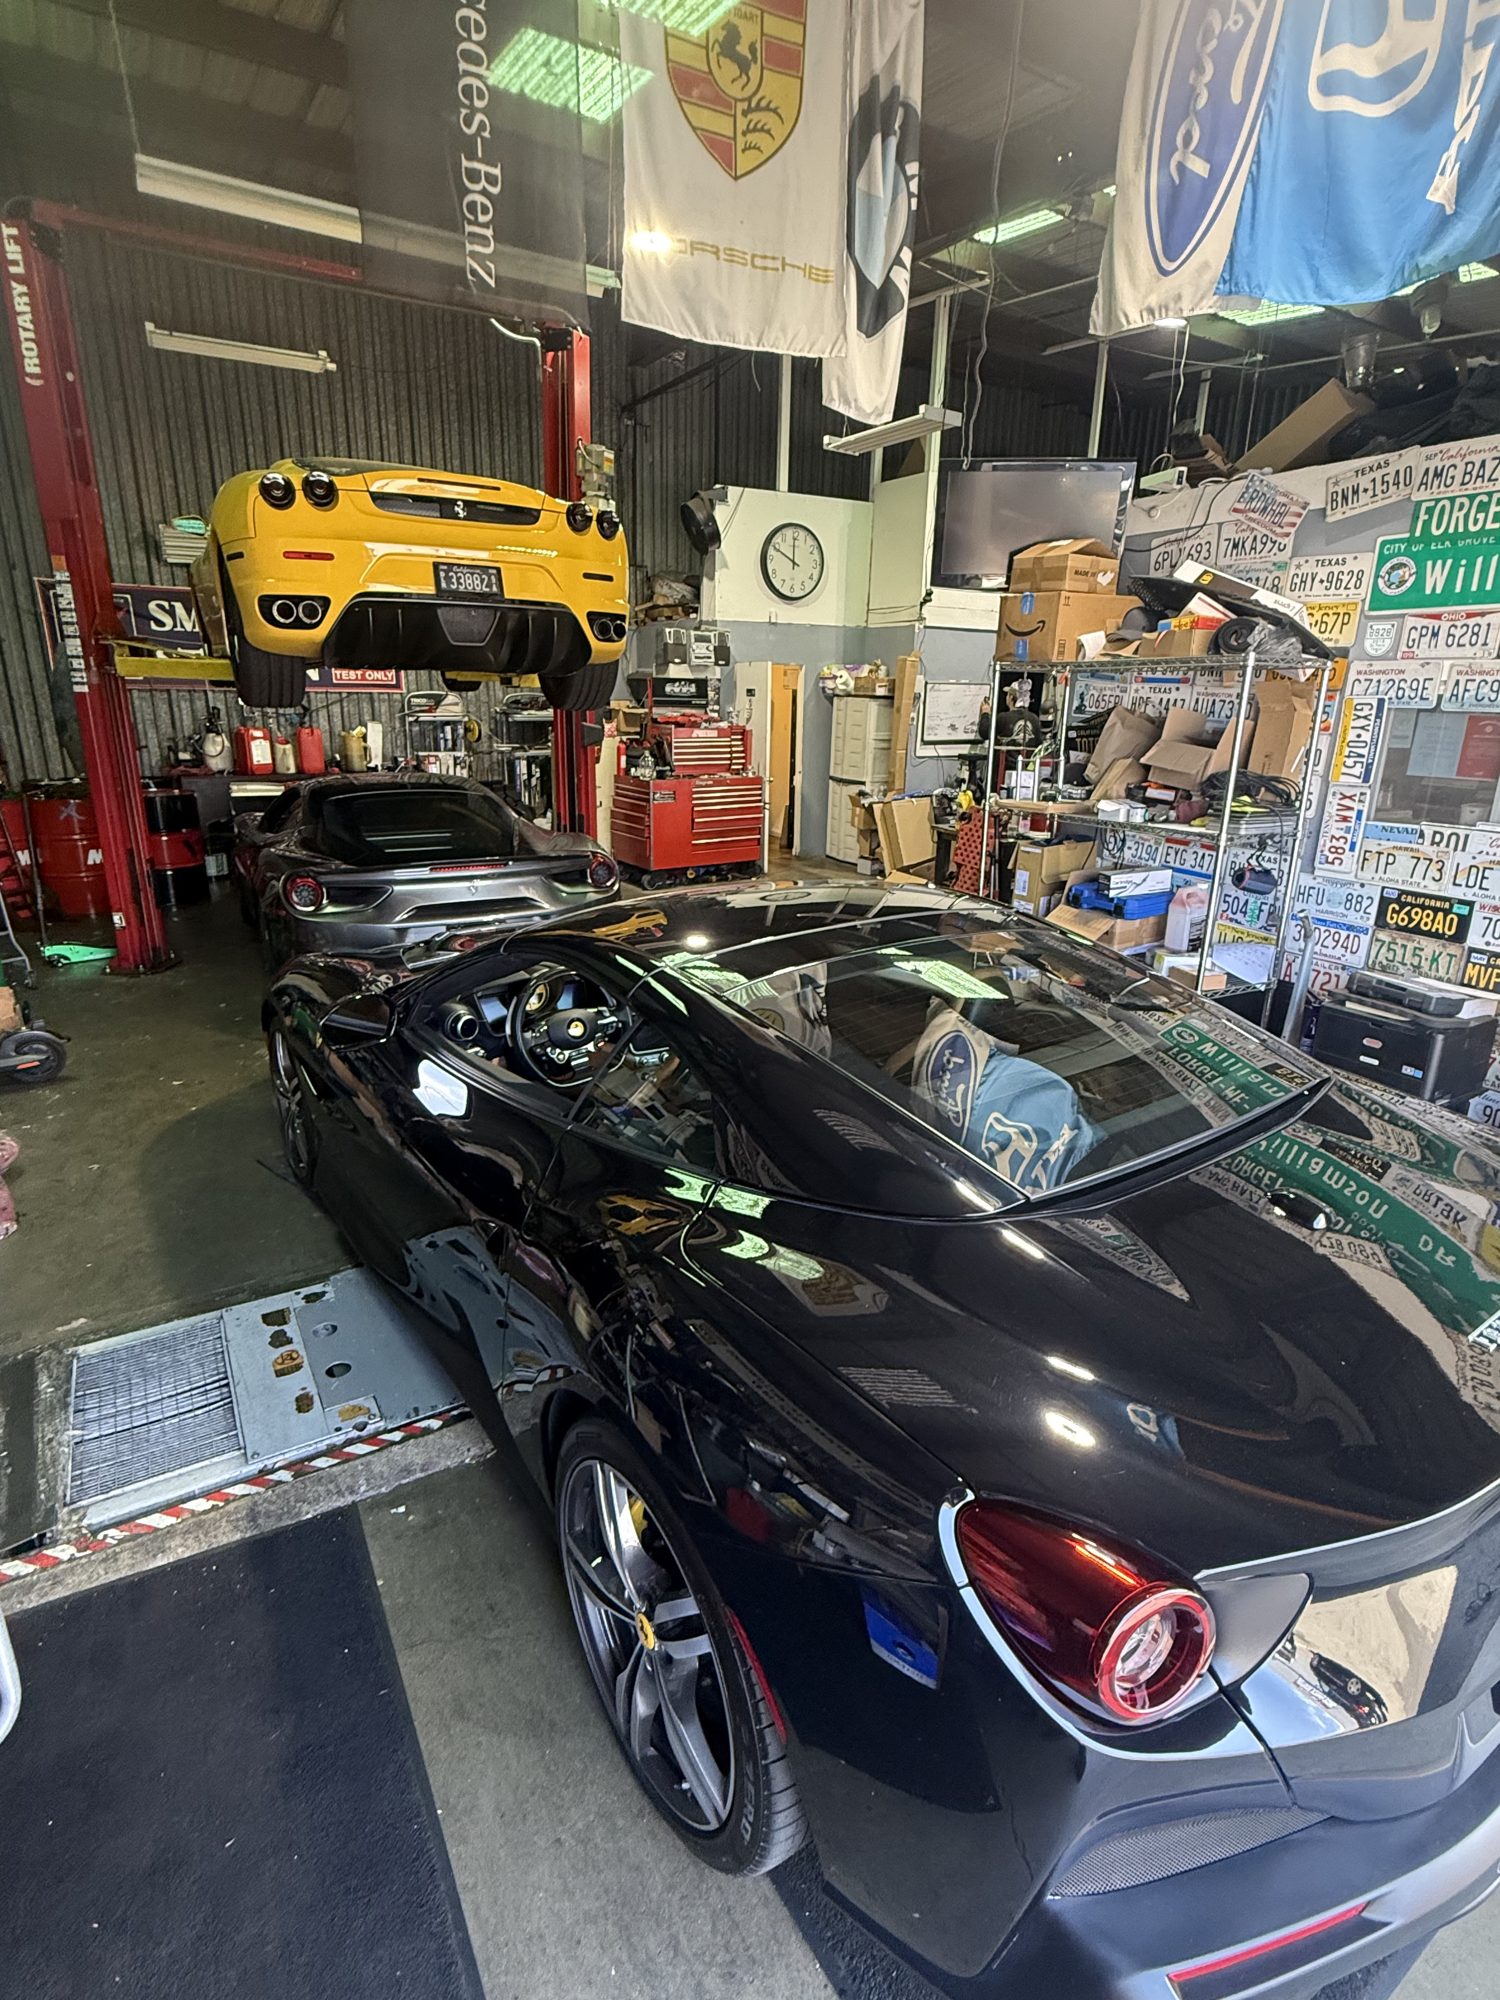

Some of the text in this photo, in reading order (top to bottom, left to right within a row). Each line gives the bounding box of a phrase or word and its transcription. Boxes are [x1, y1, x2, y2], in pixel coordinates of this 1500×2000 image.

[1, 223, 42, 374] ROTARY LIFT
[1425, 453, 1438, 462] SEP
[1441, 445, 1498, 462] California
[1354, 459, 1390, 478] TEXAS
[1417, 463, 1457, 492] AMG
[1330, 483, 1360, 512] BNM
[1370, 465, 1413, 499] 1540
[809, 544, 816, 555] 2
[1384, 543, 1407, 555] CITY
[768, 555, 774, 563] 9
[812, 559, 818, 569] 3
[1315, 558, 1347, 568] TEXAS
[449, 572, 490, 592] 33882
[771, 569, 777, 579] 8
[808, 573, 814, 581] 4
[1290, 572, 1318, 593] GHY
[1325, 570, 1365, 591] 9628
[1425, 553, 1500, 595] Will
[780, 579, 786, 588] 7
[789, 584, 795, 593] 6
[800, 581, 806, 591] 5
[1441, 611, 1466, 621] OHIO
[1407, 622, 1492, 649] GPM 6281
[335, 669, 393, 681] TEST ONLY
[1149, 686, 1172, 694] TEXAS
[1340, 702, 1375, 780] GXY 0457
[1335, 792, 1358, 823] WVX
[1325, 834, 1348, 867] 583
[1392, 844, 1420, 853] HAWAII
[1164, 846, 1214, 872] EYG 347
[1361, 850, 1446, 883] FTP 773
[1379, 876, 1421, 888] ALOHA STATE
[1452, 862, 1494, 892] LDE
[1296, 884, 1374, 915] HFU 882
[1401, 894, 1450, 909] CALIFORNIA
[1472, 892, 1496, 901] ALOHA
[1222, 893, 1249, 918] 504
[1374, 939, 1457, 976] 7515 KT
